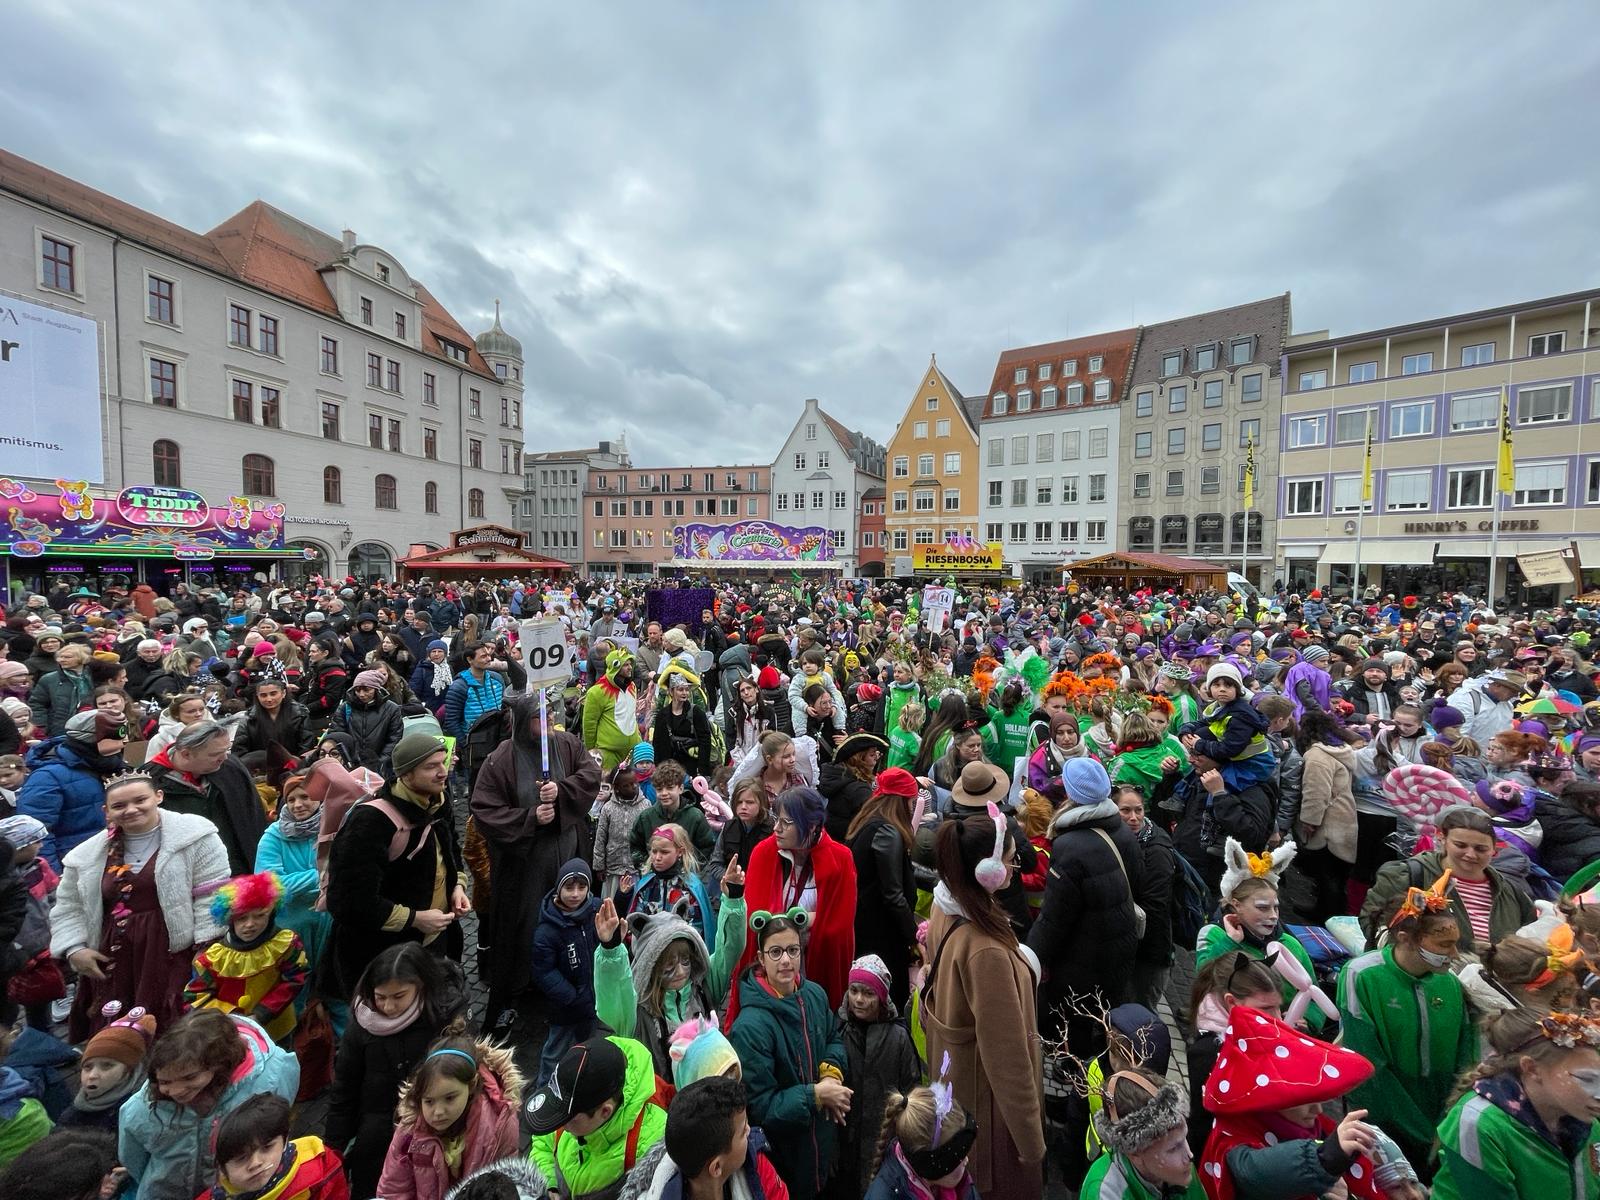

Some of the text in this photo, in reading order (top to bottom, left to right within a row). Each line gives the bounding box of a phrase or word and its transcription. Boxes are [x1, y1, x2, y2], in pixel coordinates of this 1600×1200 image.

[0, 436, 64, 451] mitismus.
[128, 493, 201, 512] TEDDY
[145, 510, 188, 524] XXL
[1404, 519, 1539, 533] HENRY'S COFFEE
[925, 555, 993, 564] RIESENBOSNA
[941, 594, 949, 603] 14
[613, 629, 625, 637] 23
[529, 644, 564, 669] 09
[567, 943, 578, 970] TECH
